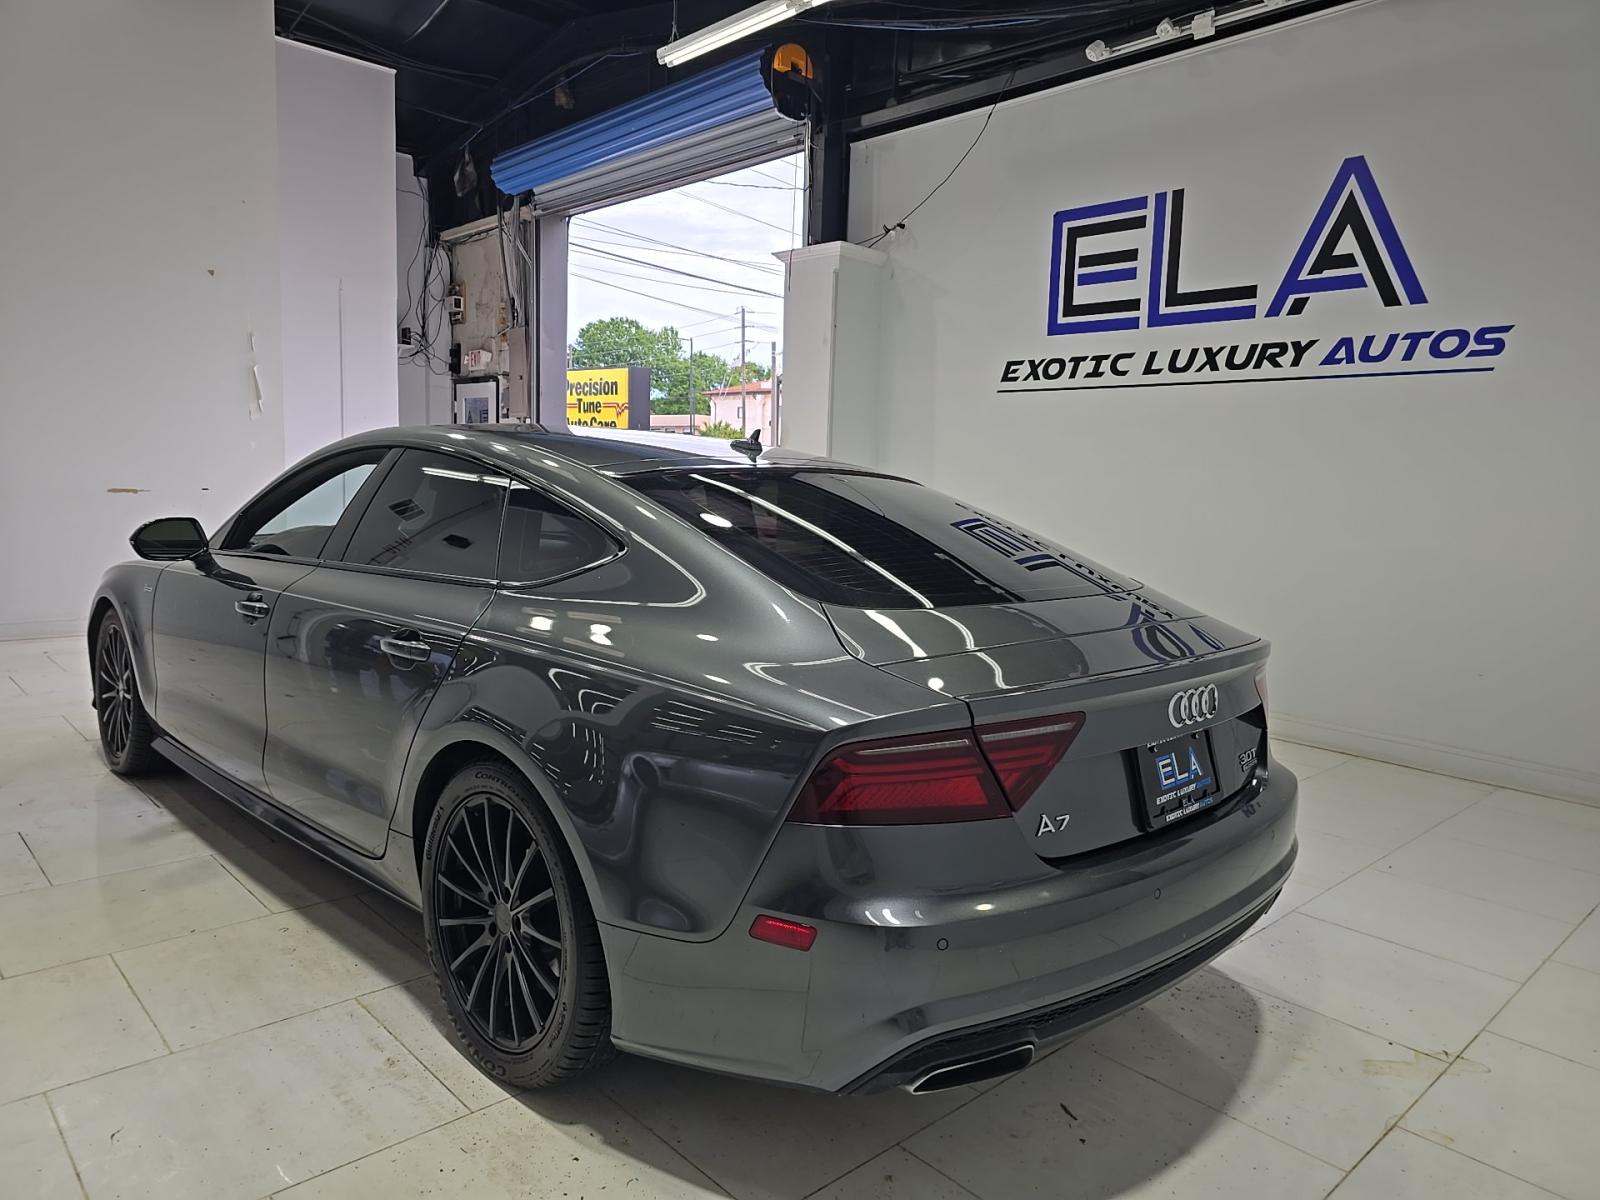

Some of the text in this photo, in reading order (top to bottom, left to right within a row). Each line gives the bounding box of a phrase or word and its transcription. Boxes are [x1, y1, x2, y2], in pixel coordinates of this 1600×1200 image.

[1047, 155, 1429, 336] ELA
[1000, 325, 1516, 382] EXOTIC LUXURY AUTOS
[577, 398, 602, 413] Tune
[1155, 746, 1202, 790] ELA
[1036, 813, 1070, 837] A7
